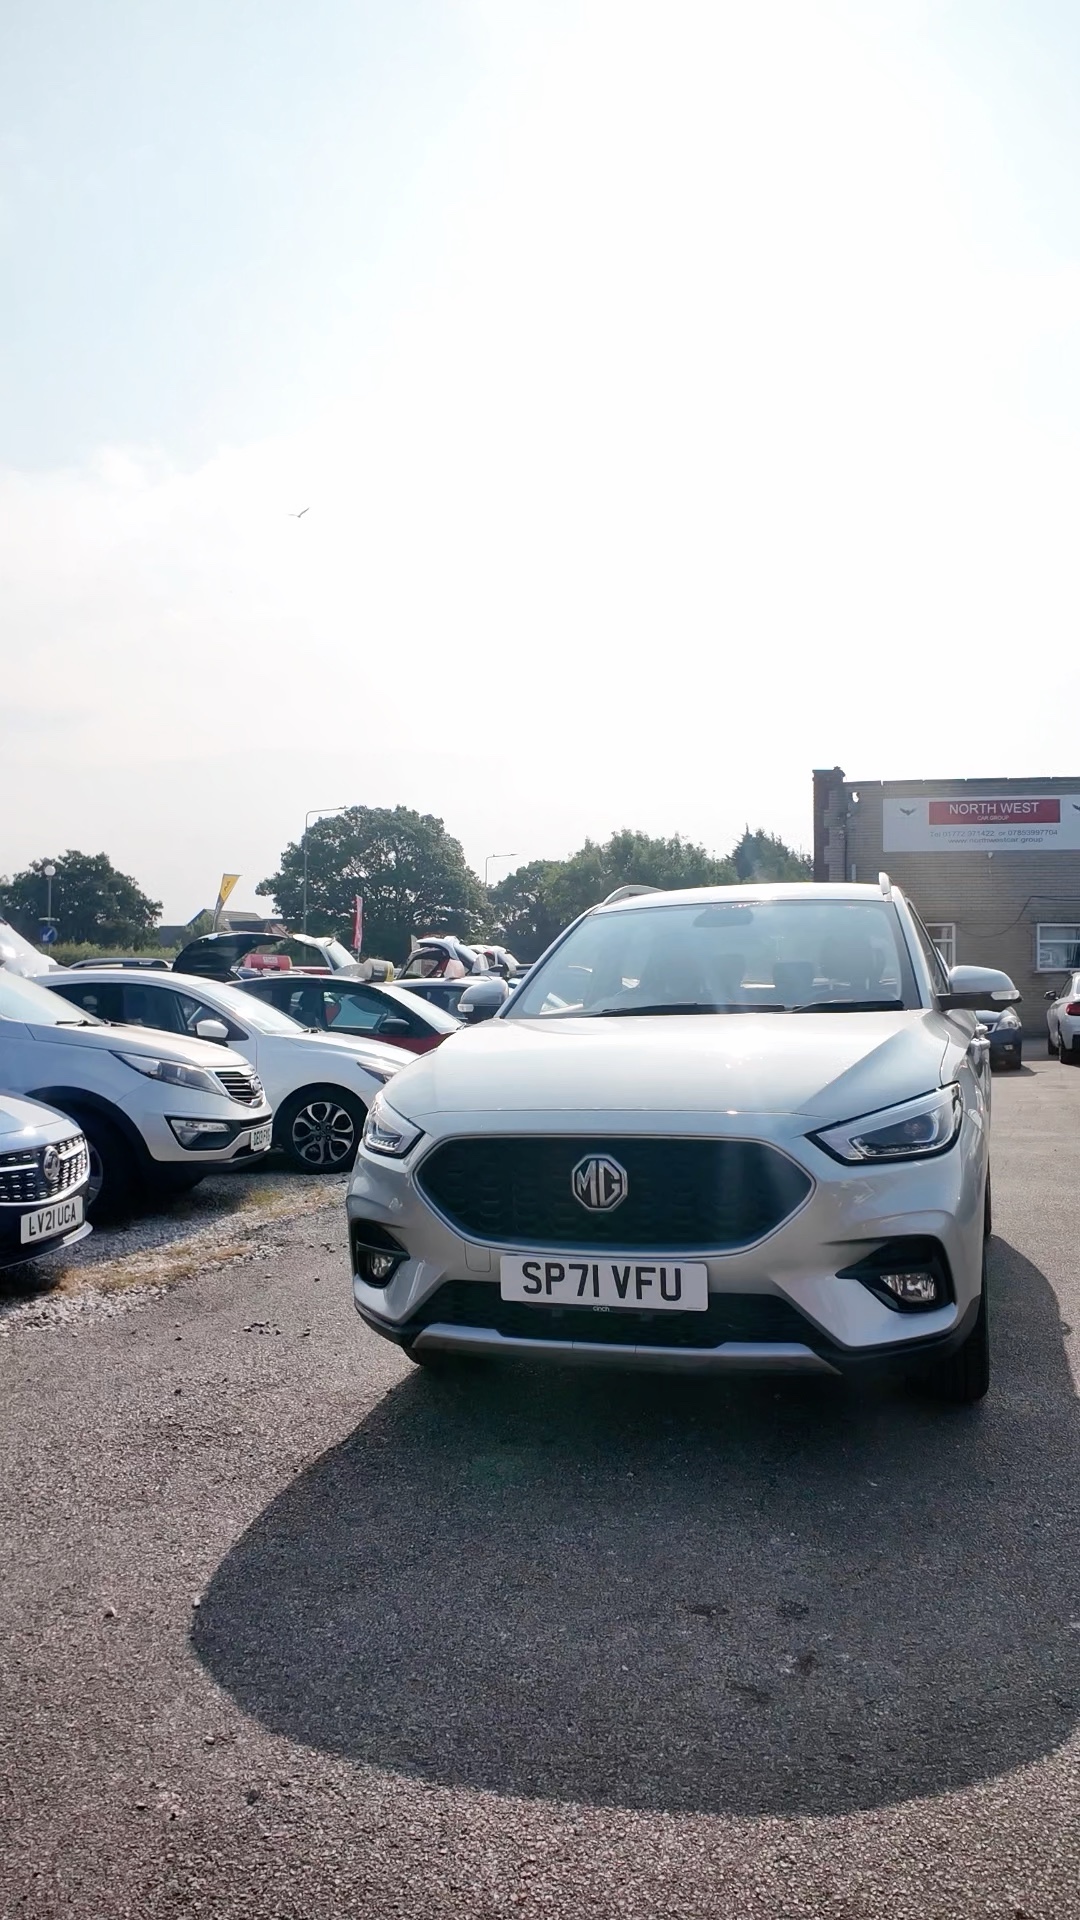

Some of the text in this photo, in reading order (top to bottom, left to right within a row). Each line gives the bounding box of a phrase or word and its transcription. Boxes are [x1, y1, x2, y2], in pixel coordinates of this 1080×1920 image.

[949, 802, 1039, 815] NORTH WEST
[576, 1160, 621, 1206] MG
[29, 1202, 77, 1236] LV21 UCA
[522, 1261, 682, 1302] SP71 VFU
